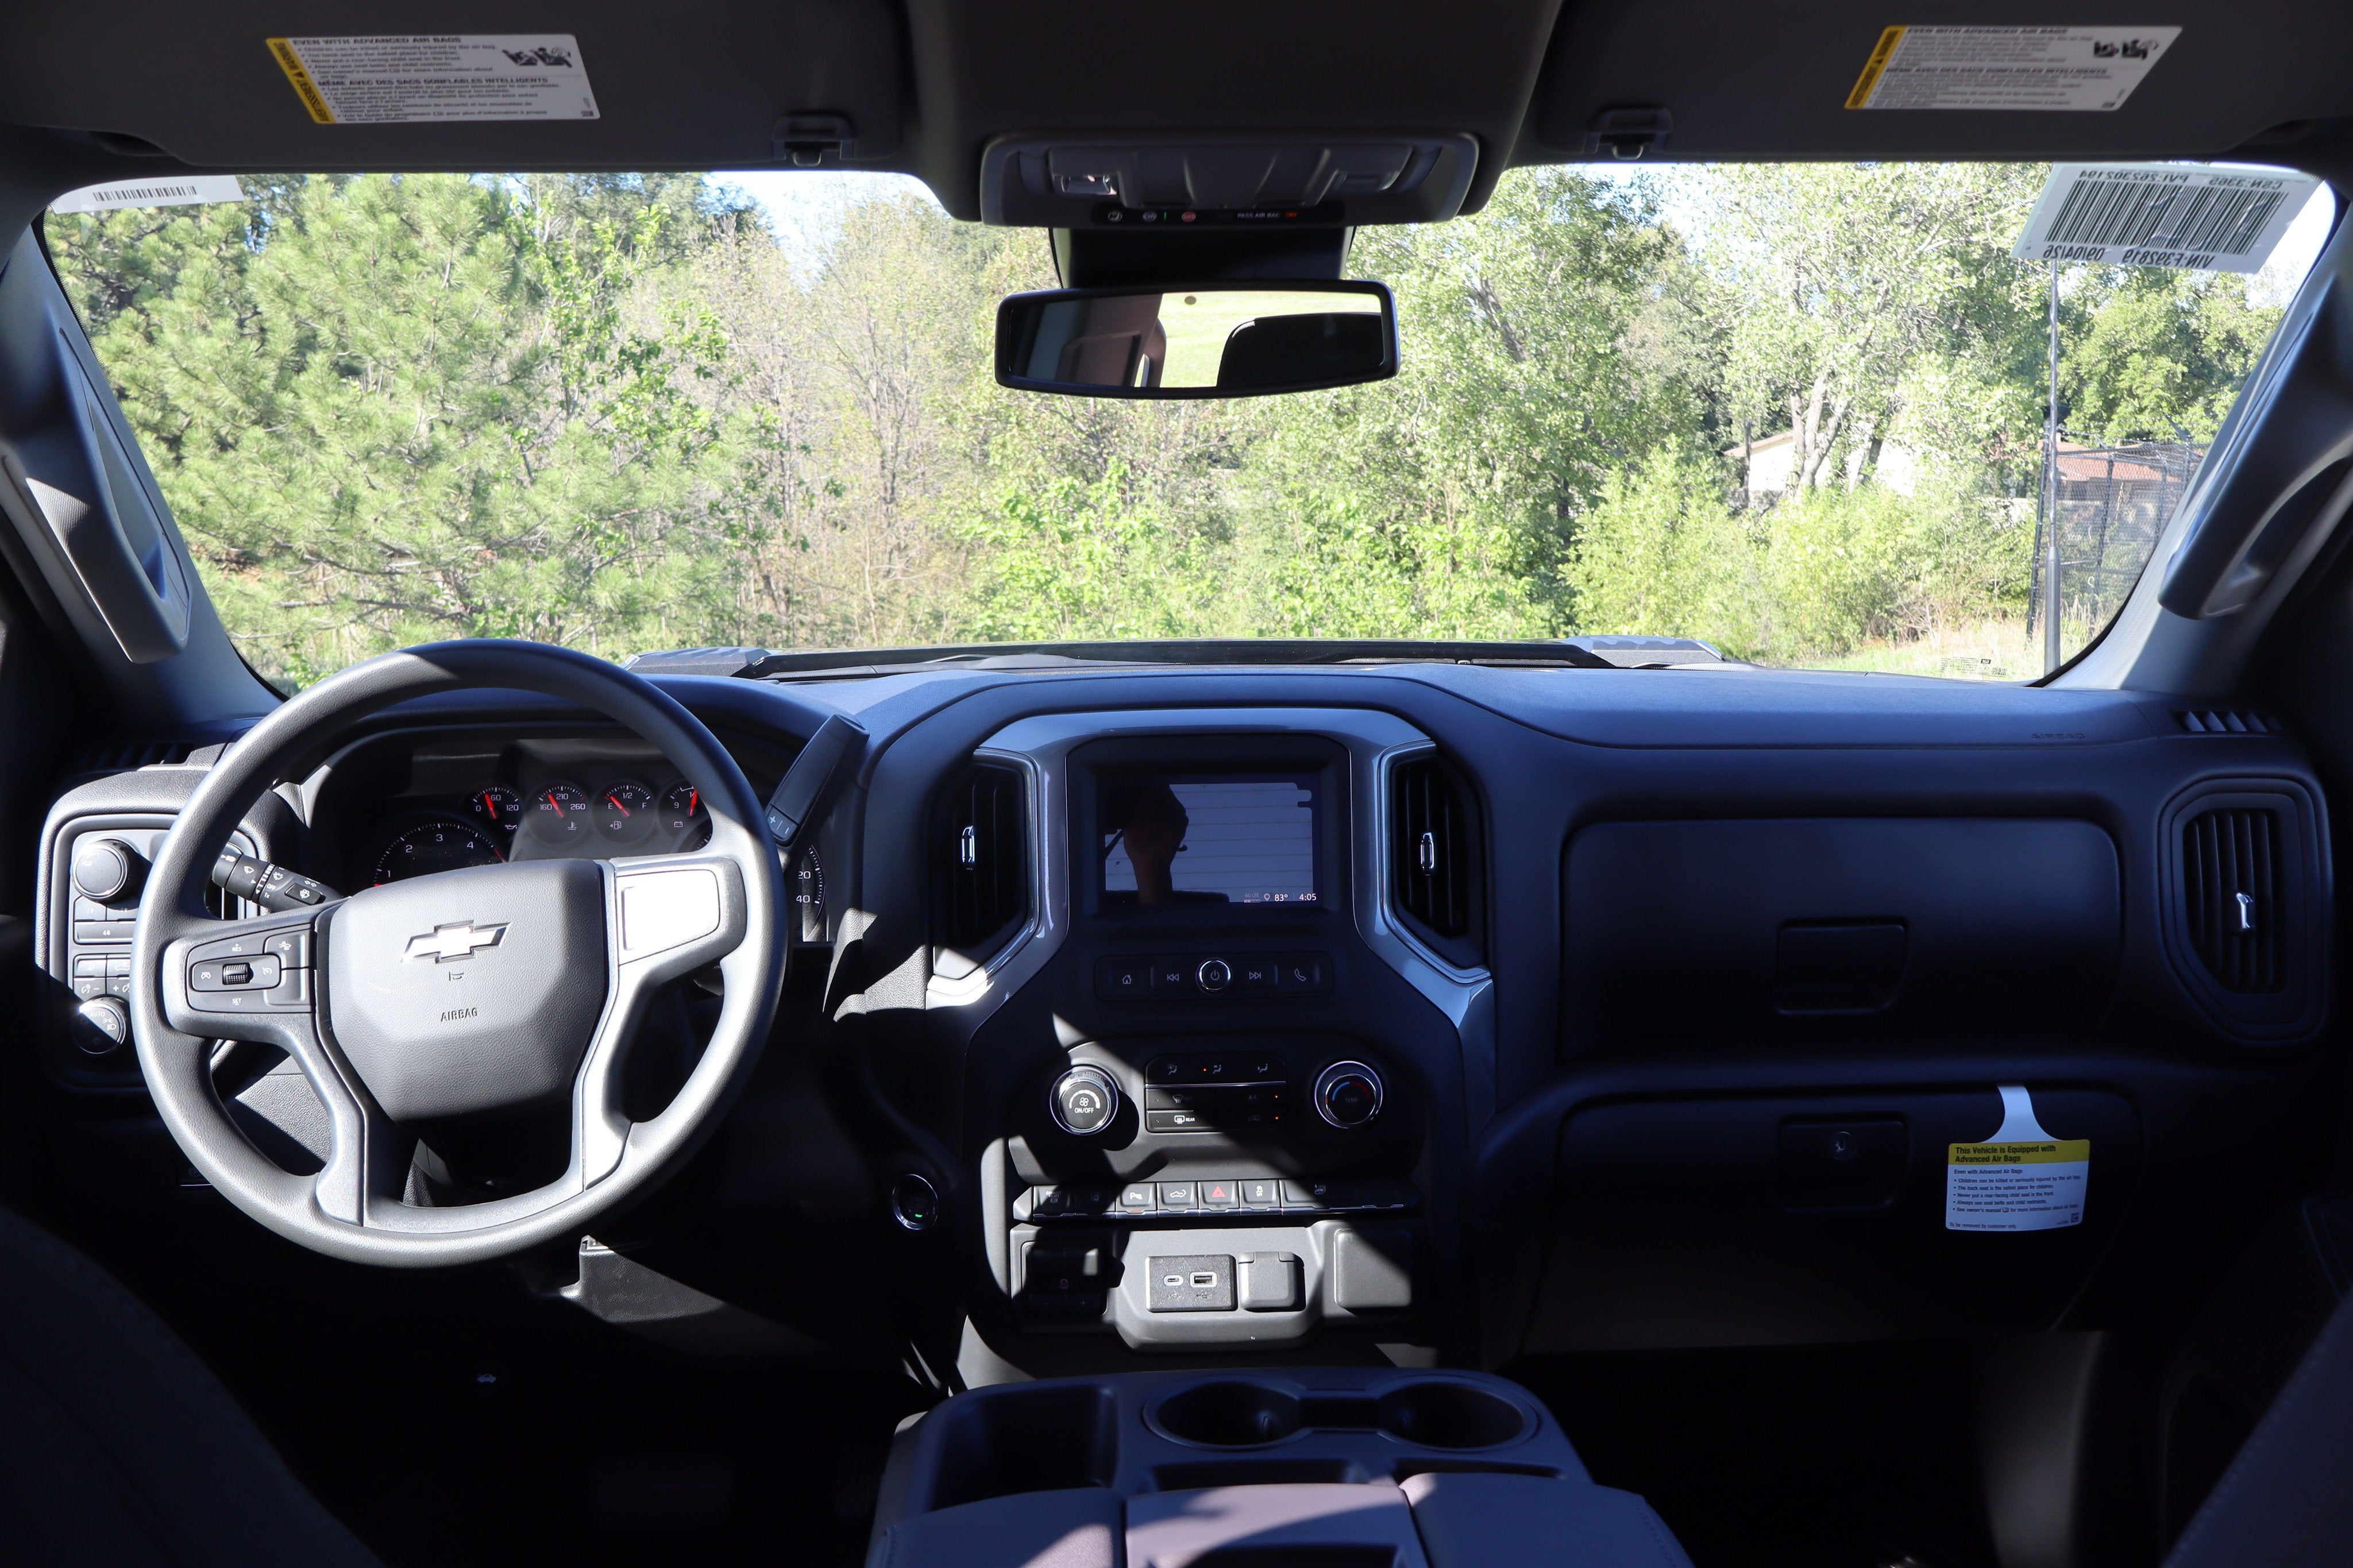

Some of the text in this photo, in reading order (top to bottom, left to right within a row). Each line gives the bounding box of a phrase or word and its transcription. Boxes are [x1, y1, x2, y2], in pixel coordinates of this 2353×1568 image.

[406, 845, 412, 853] 2
[466, 841, 474, 849] 4
[799, 871, 811, 879] 20
[796, 895, 810, 903] 40
[441, 1007, 478, 1022] AIRBAG
[2007, 1146, 2039, 1154] Equipped
[2004, 1155, 2021, 1163] Bags
